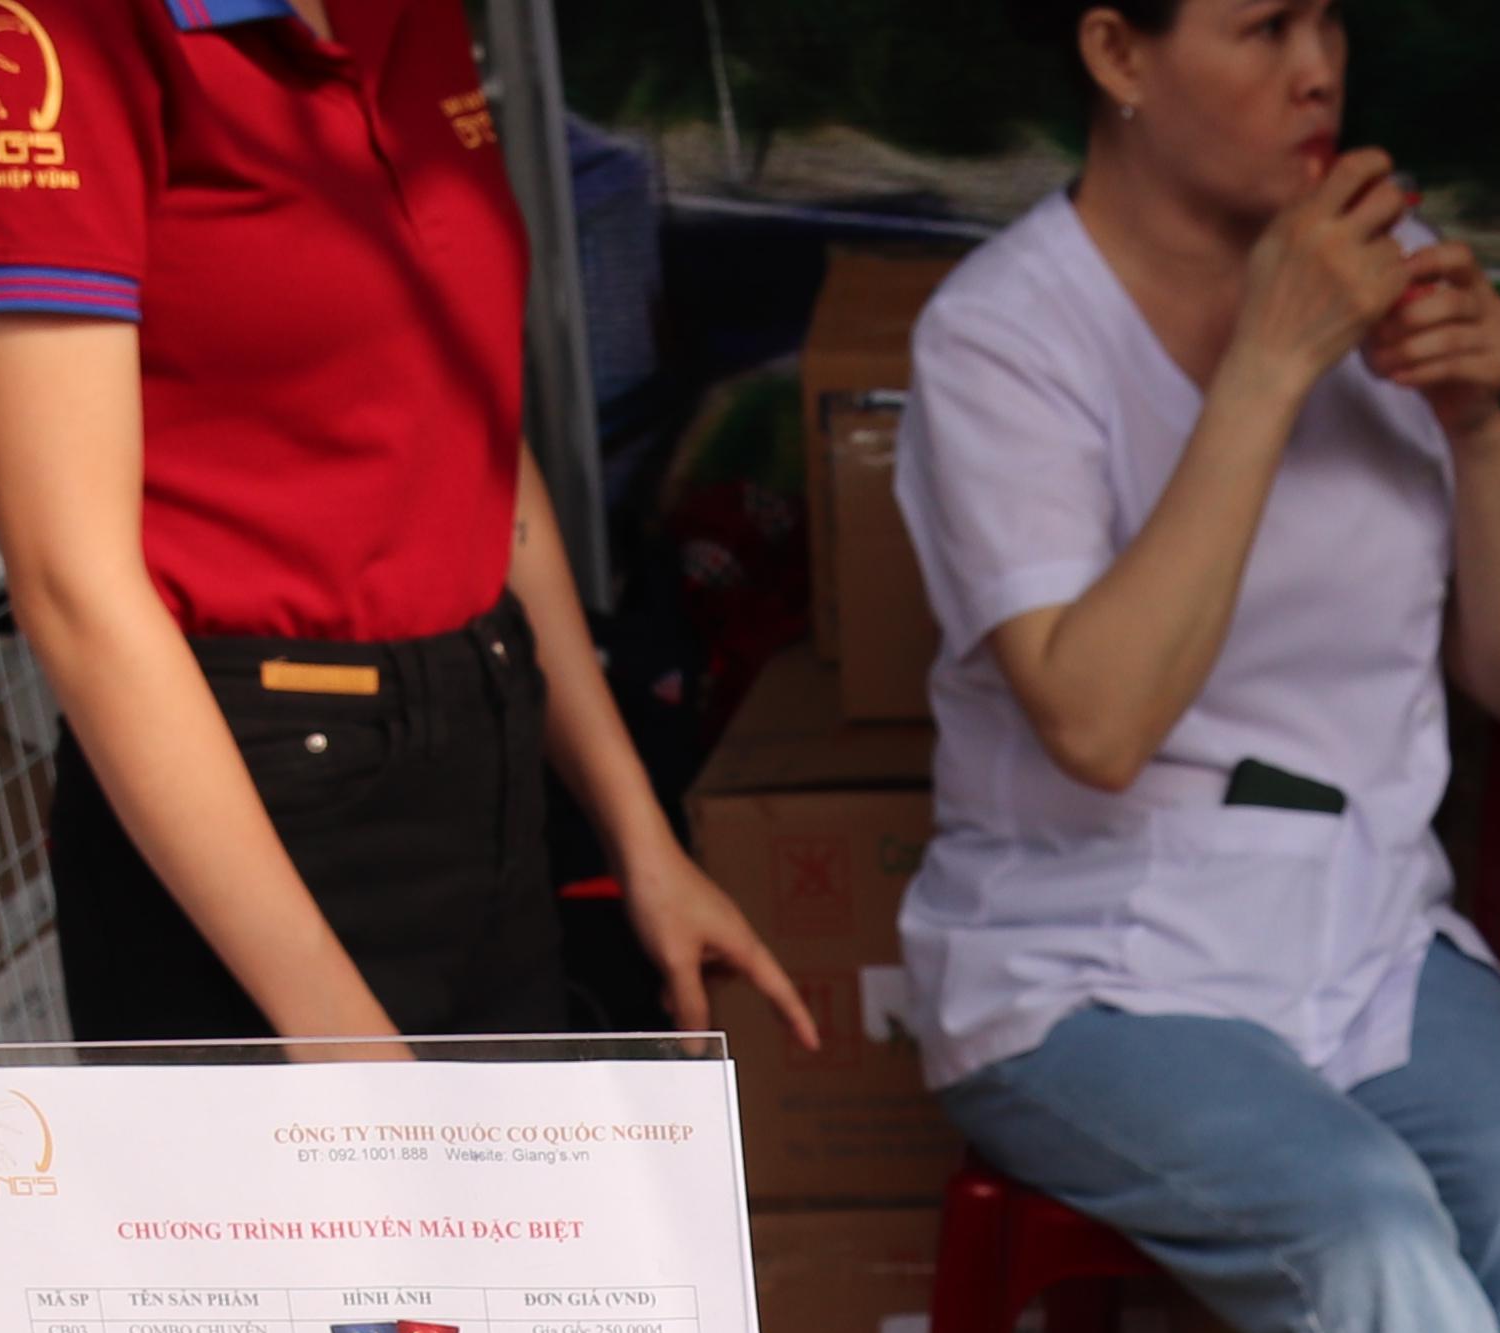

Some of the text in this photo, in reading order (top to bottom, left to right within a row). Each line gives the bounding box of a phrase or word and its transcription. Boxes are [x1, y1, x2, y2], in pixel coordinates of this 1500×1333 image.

[274, 1121, 694, 1145] CÔNG TY TNHH QUỐC CƠ QUỐC NGHIỆP
[445, 1148, 507, 1162] Website:
[512, 1148, 590, 1165] Giang's.vn
[118, 1215, 584, 1244] CHƯƠNG TRÌNH KHUYẾN MÃI ĐẶC BIỆT
[37, 1289, 89, 1307] MÃ SP
[128, 1290, 164, 1307] TÊN
[166, 1289, 202, 1307] SẢN
[342, 1288, 432, 1306] HÌNH ẢNH
[524, 1289, 656, 1307] ĐƠN GIÁ (VND)
